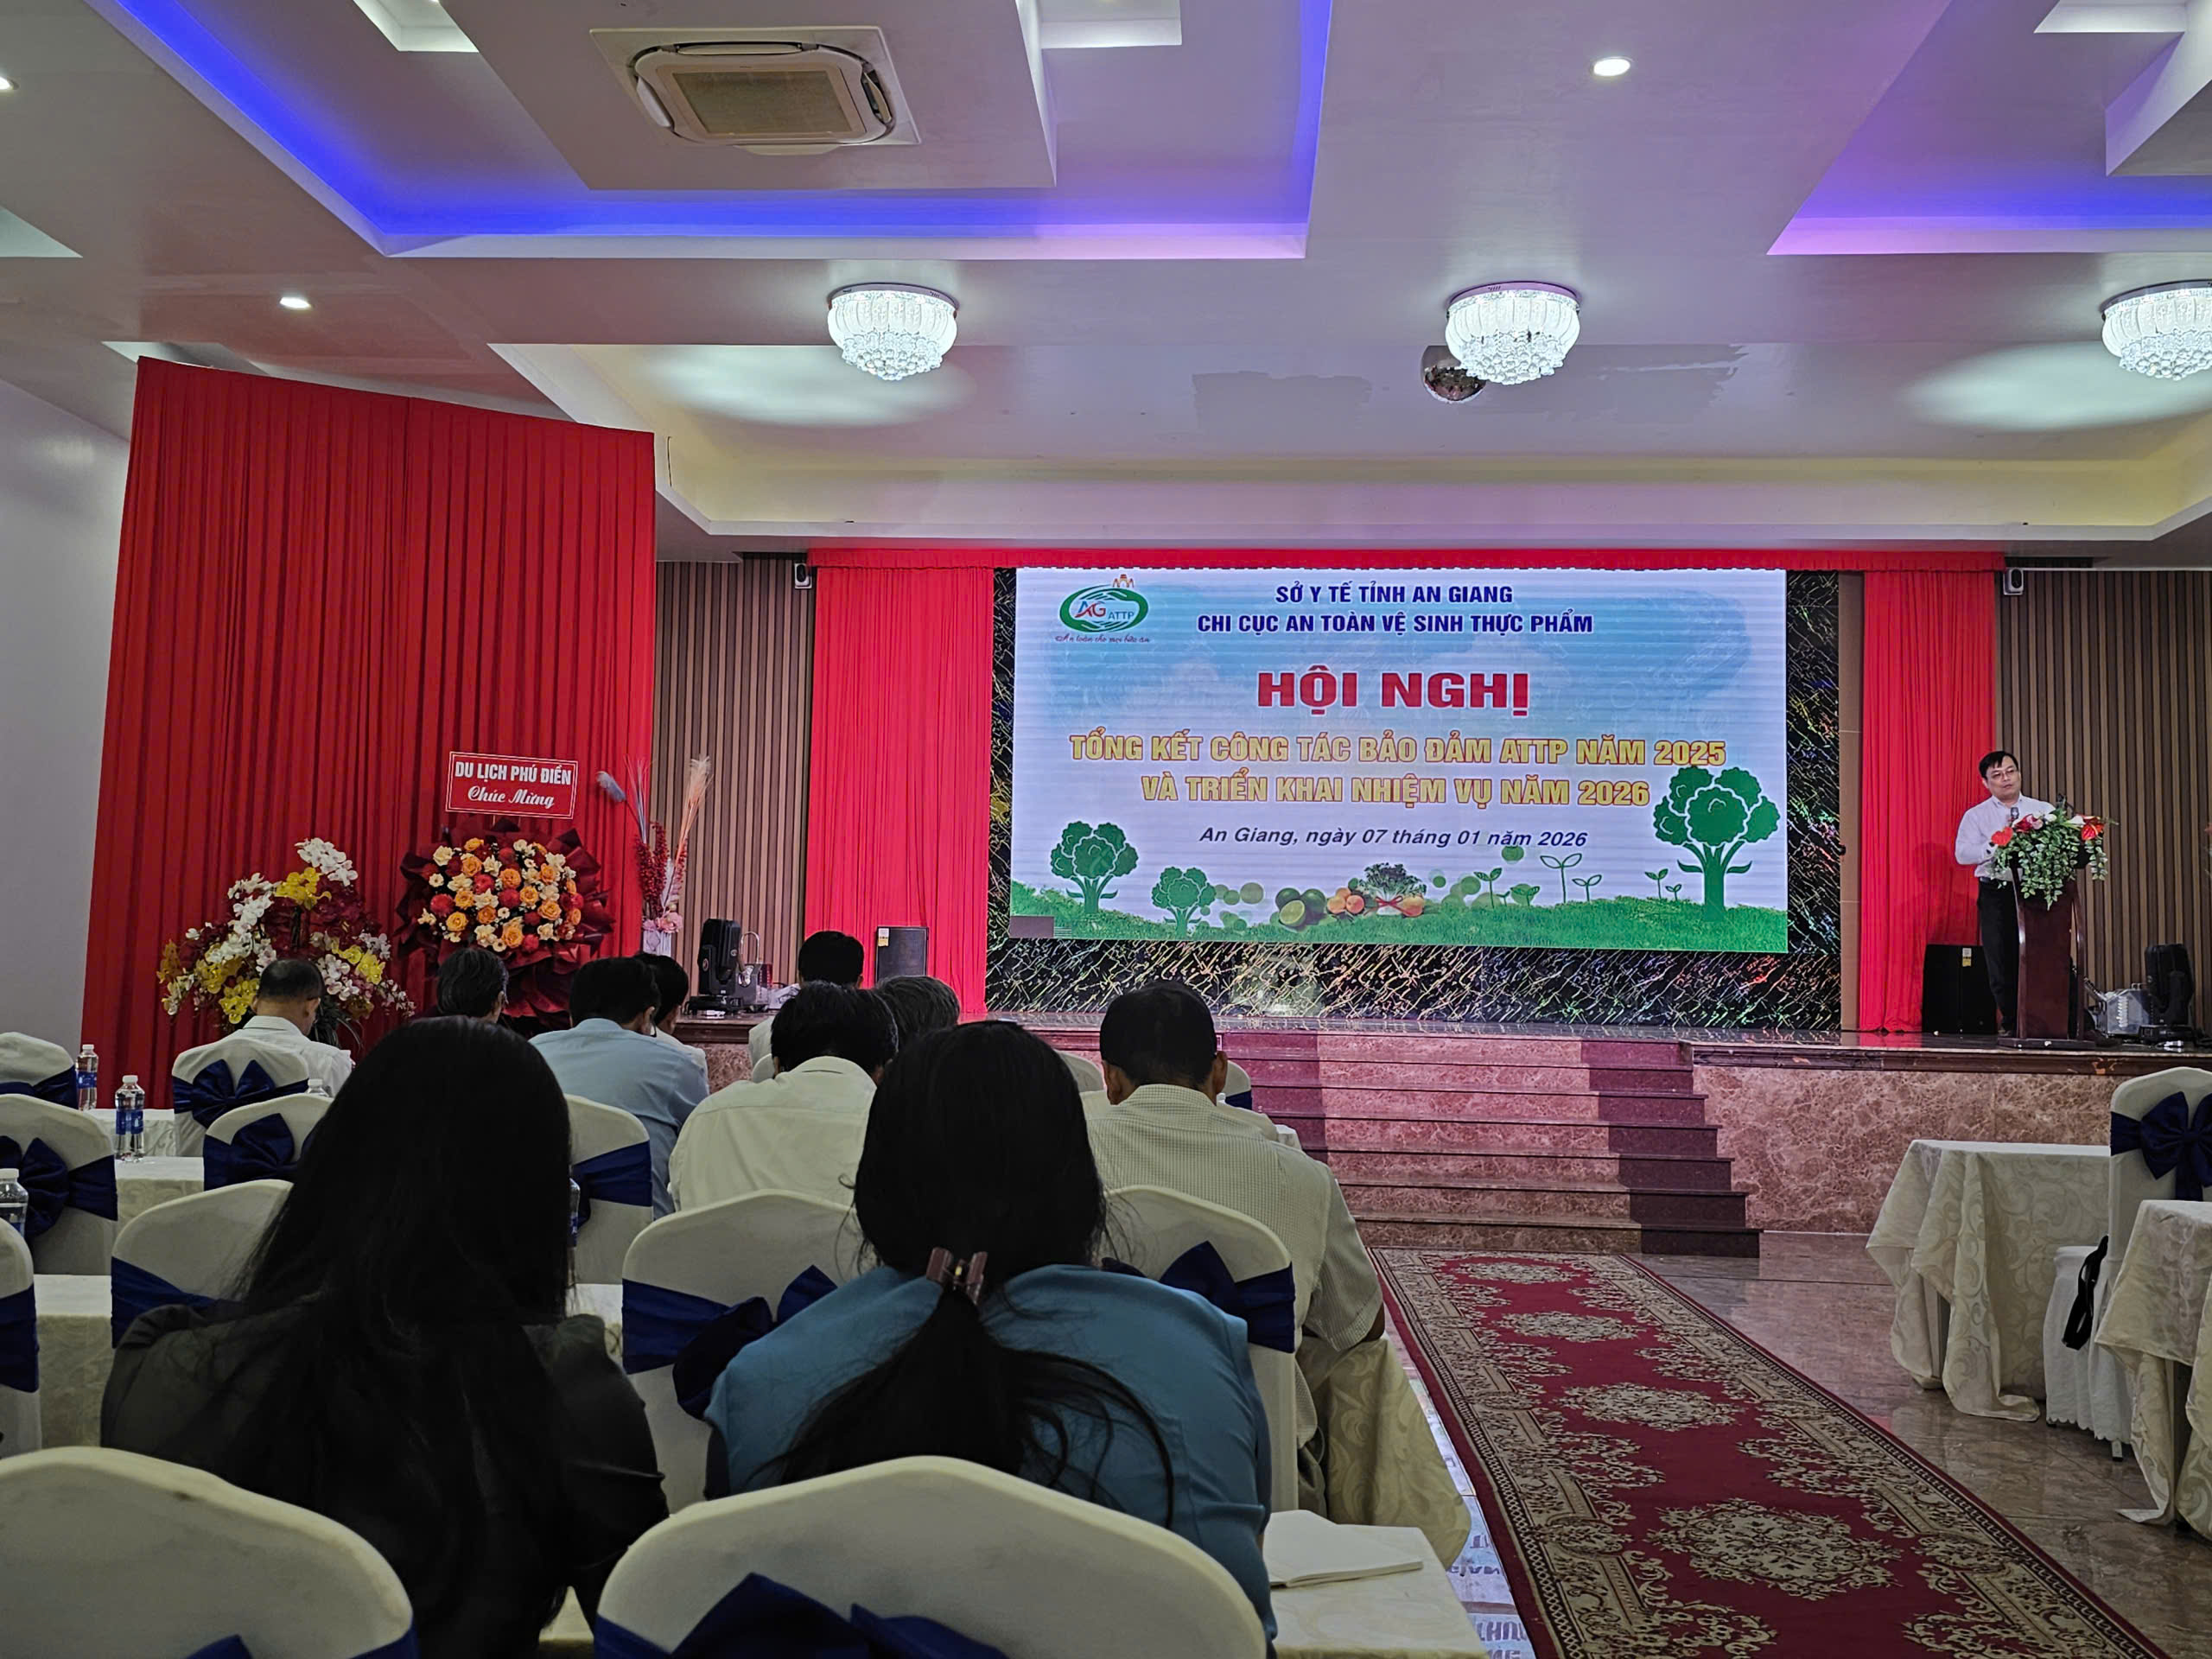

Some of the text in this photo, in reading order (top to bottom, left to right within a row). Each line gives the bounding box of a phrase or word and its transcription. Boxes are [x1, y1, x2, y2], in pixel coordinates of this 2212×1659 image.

[1275, 581, 1512, 603] SỞ Y TẾ TỈNH AN GIANG
[1108, 611, 1135, 620] ATTP
[1198, 608, 1592, 636] CHI CỤC AN TOÀN VỆ SINH THỰC PHẨM
[1258, 664, 1529, 716] HỘI NGHỊ
[1070, 727, 1726, 766] TỔNG KẾT CÔNG TÁC BẢO ĐẢM ATTP NĂM 2025
[455, 761, 571, 785] DU LỊCH PHÚ ĐIỀN
[467, 785, 555, 809] Chúc Mừng
[1141, 767, 1650, 809] VÀ TRIỂN KHAI NHIỆM VỤ NĂM 2026
[1199, 827, 1588, 848] An Giang, ngày 07 tháng 01 năm 2026
